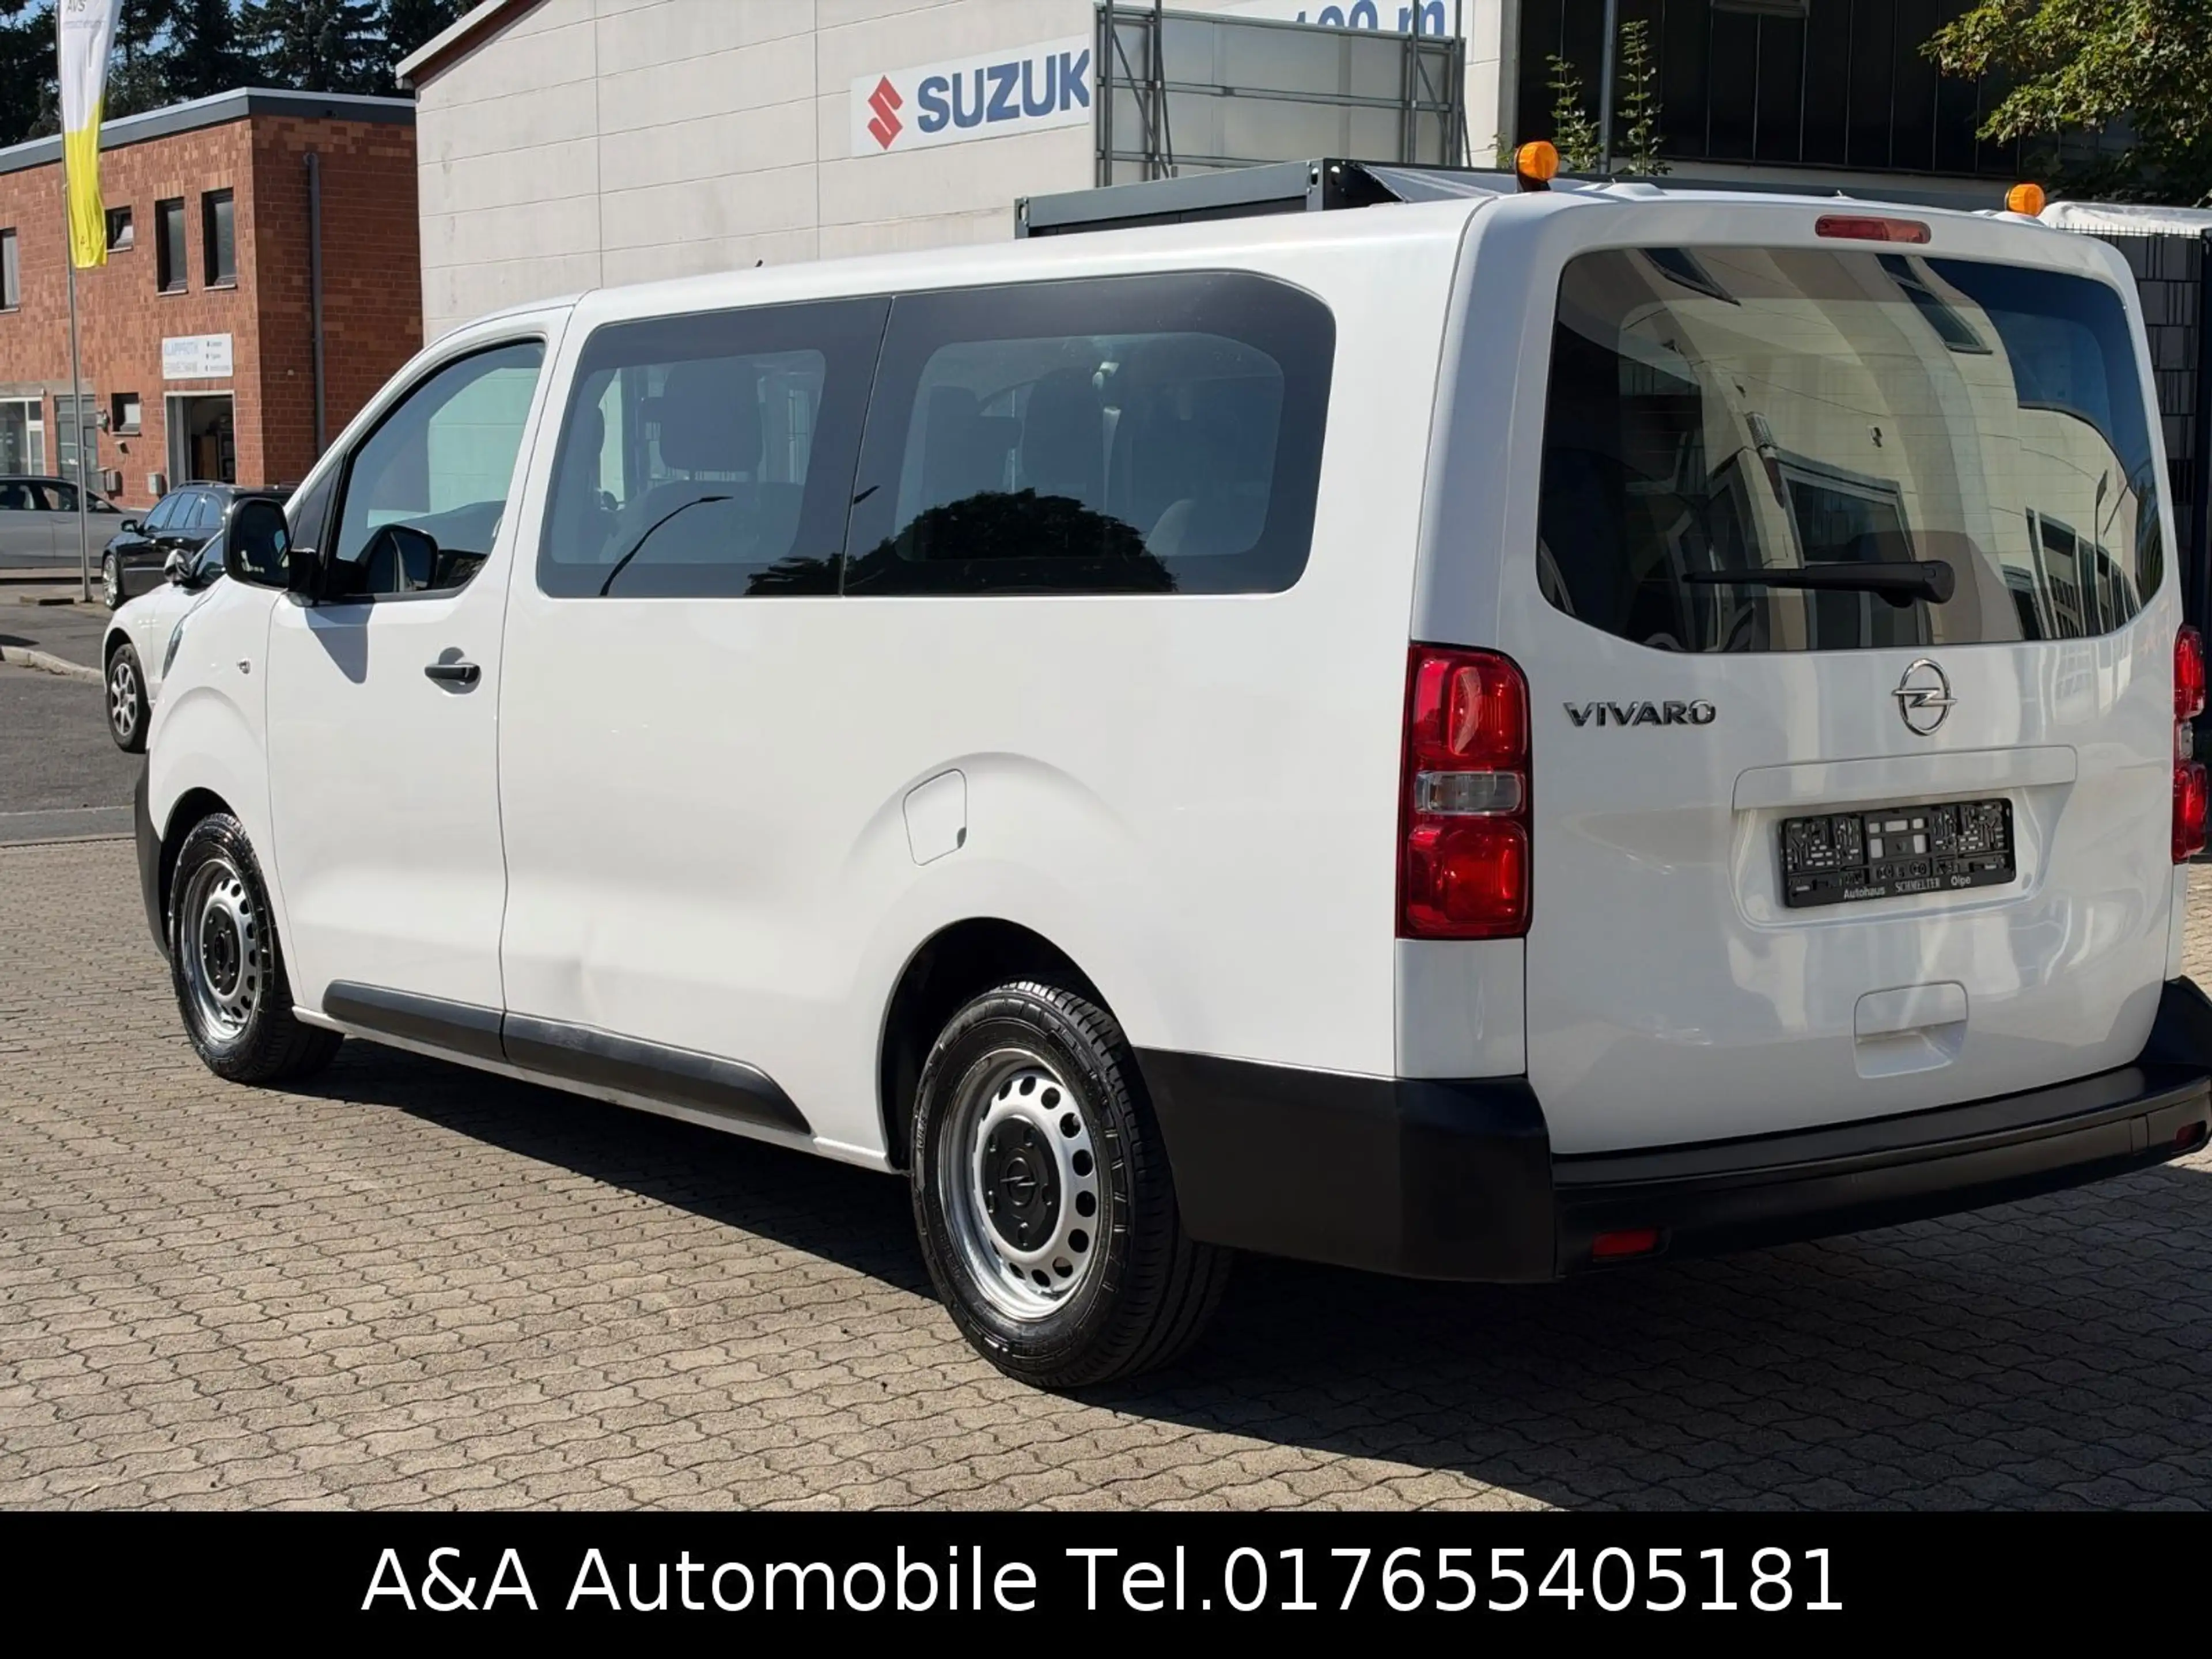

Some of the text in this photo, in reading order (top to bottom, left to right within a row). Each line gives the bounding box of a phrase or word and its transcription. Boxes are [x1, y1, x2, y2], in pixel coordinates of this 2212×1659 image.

[918, 48, 1090, 133] SUZUK
[1562, 699, 1717, 726] VIVARO
[1844, 885, 1885, 899] Autohaus
[1950, 875, 1971, 887] Olpe
